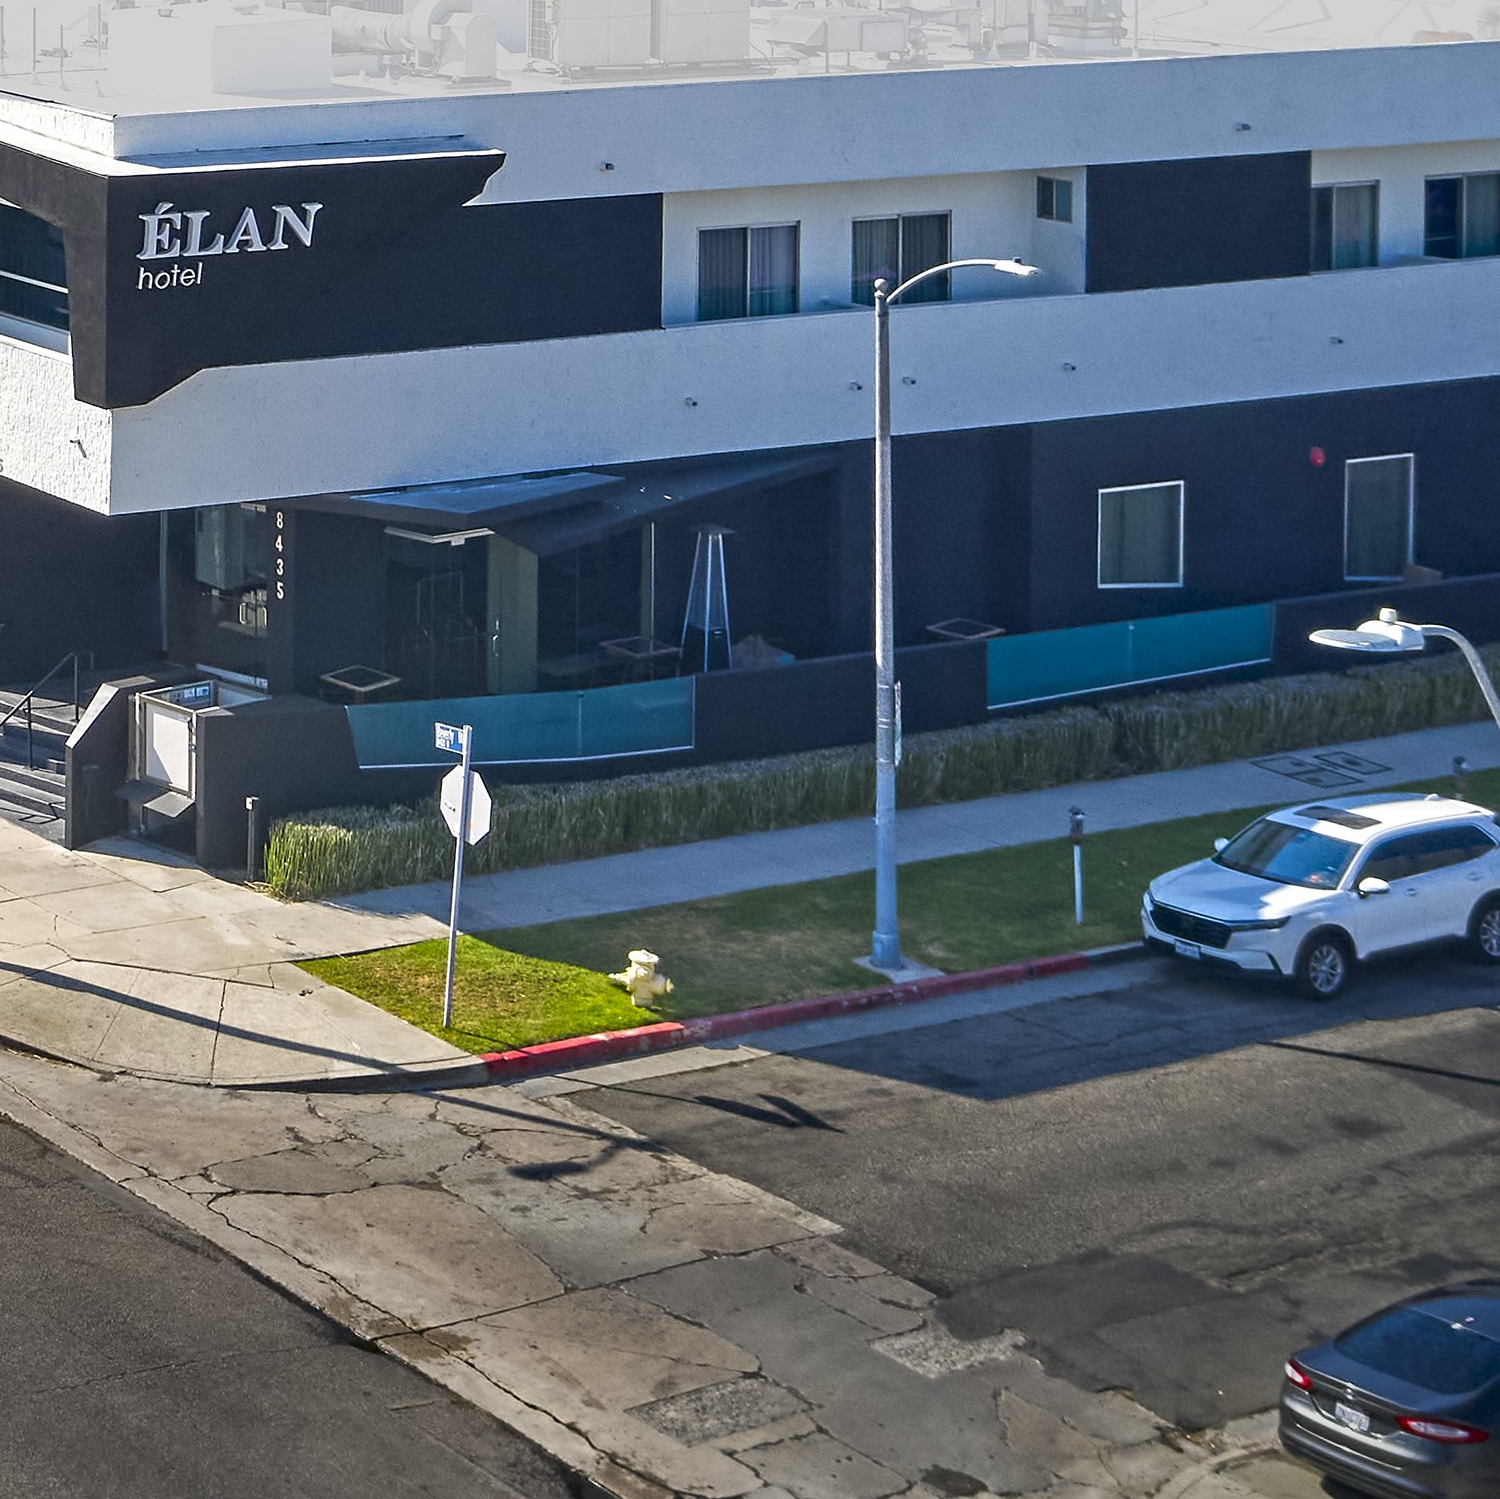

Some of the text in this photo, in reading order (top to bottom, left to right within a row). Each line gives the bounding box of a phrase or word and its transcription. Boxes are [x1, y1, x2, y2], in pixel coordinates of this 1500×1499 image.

[136, 202, 323, 259] ÉLAN
[136, 262, 203, 290] hotel
[275, 511, 284, 599] 8435
